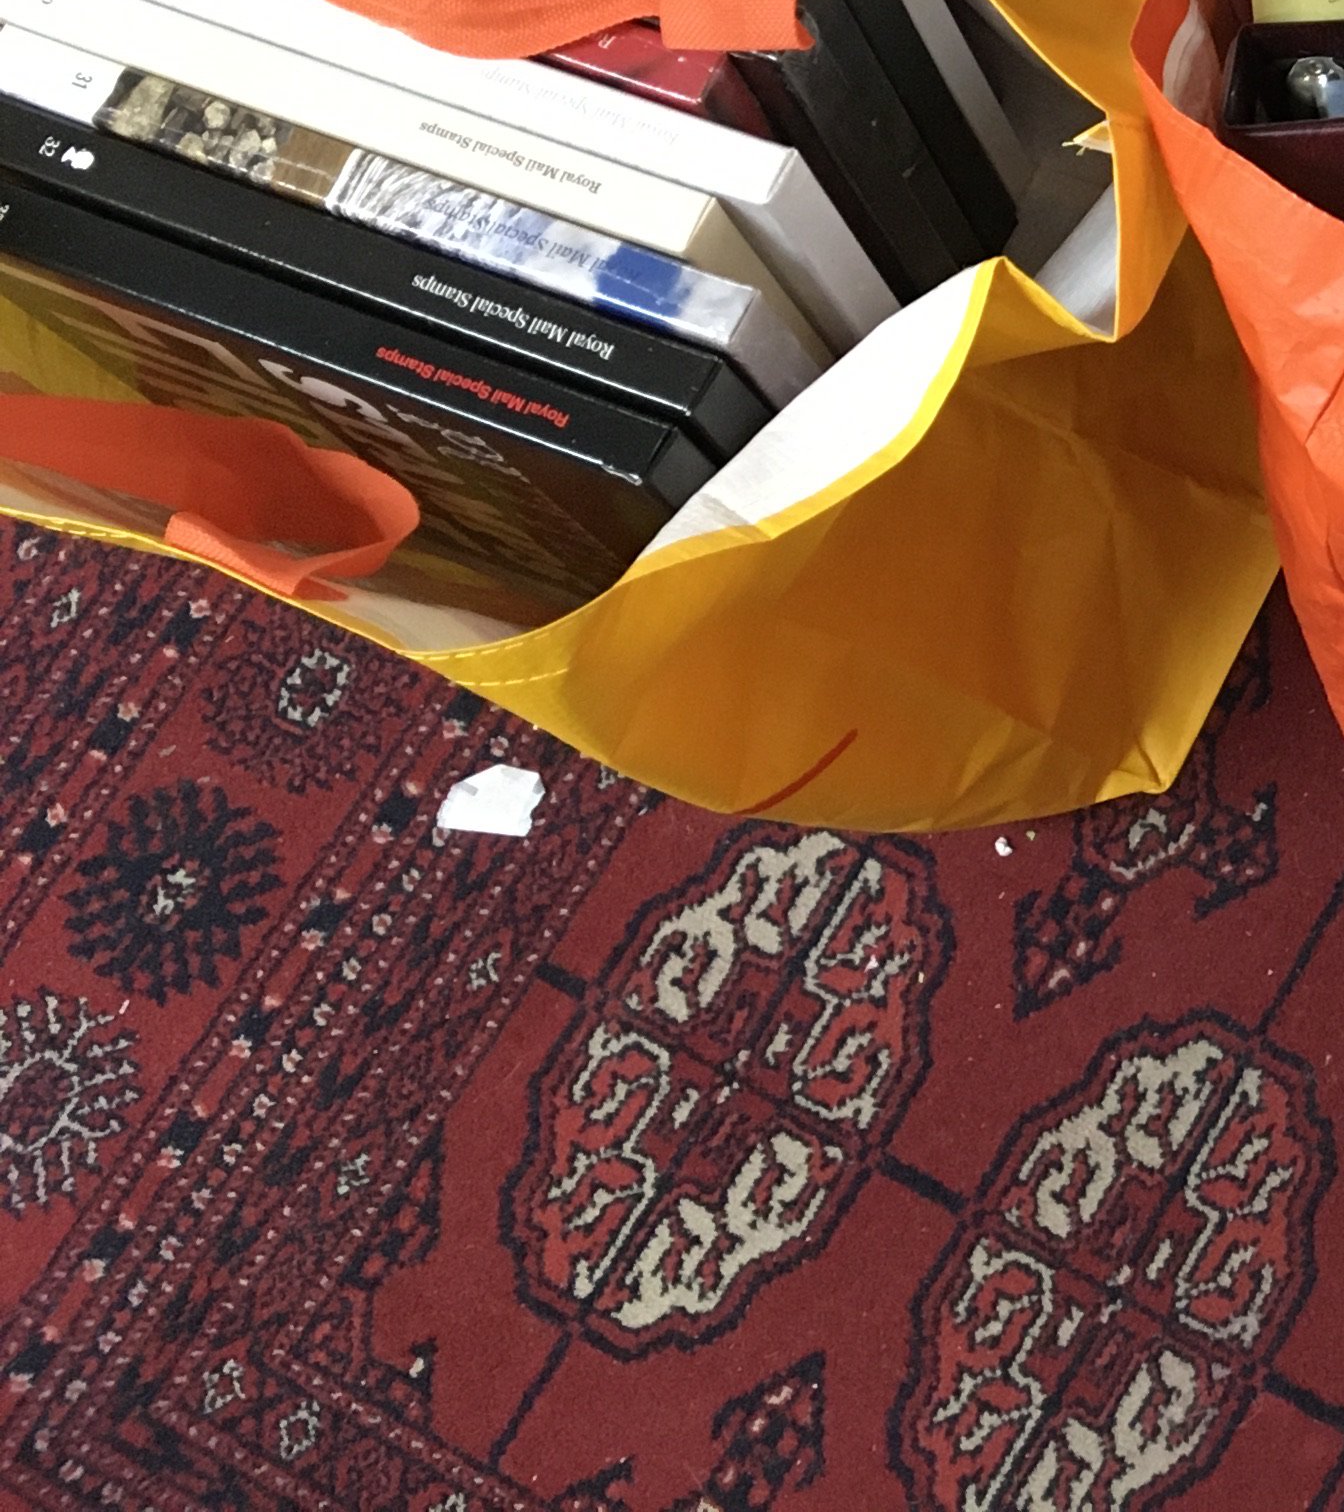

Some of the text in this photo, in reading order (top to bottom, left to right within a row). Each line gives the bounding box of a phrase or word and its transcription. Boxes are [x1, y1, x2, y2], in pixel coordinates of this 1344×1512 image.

[72, 72, 93, 90] 31
[38, 135, 60, 158] 32
[419, 120, 602, 196] Royal Mail Special Stamps
[551, 241, 593, 271] Mail
[411, 273, 616, 361] Royal Mail Special Stamps
[375, 345, 572, 430] Royal Mail Special Stamps
